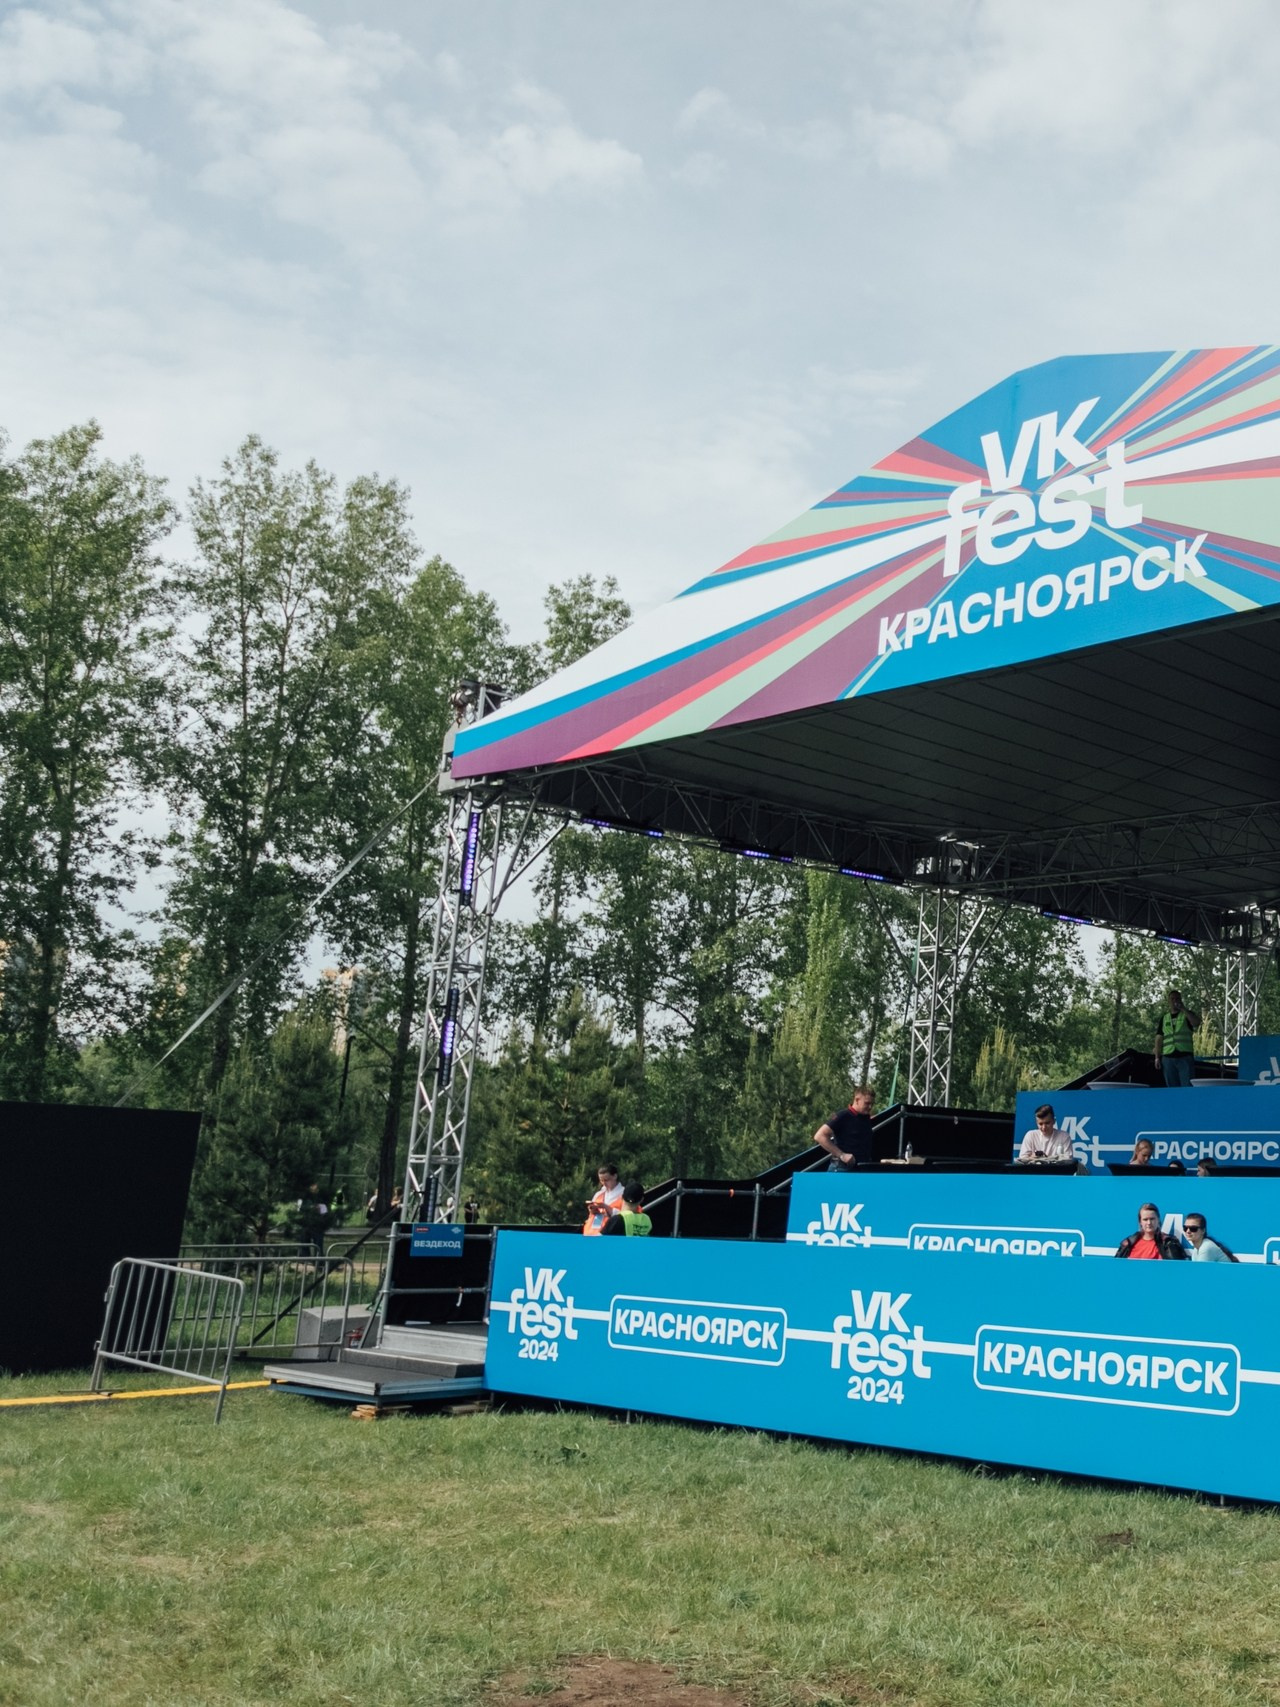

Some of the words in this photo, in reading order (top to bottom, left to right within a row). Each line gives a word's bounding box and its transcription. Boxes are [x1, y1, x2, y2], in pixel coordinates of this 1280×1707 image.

[980, 396, 1101, 493] VK
[943, 440, 1143, 578] fest
[877, 532, 1209, 656] КРАСНОЯРСК
[1072, 1136, 1104, 1167] st
[821, 1203, 865, 1232] VK
[414, 1240, 461, 1249] ВЕЗДЕХОД
[524, 1266, 568, 1303] VK
[508, 1288, 578, 1341] fest
[614, 1308, 780, 1350] КРАСНОЯРСК
[851, 1289, 913, 1333] VK
[518, 1337, 559, 1362] 2024
[830, 1314, 932, 1379] fest
[846, 1375, 905, 1405] 2024
[982, 1341, 1230, 1396] КРАСНОЯРСК
